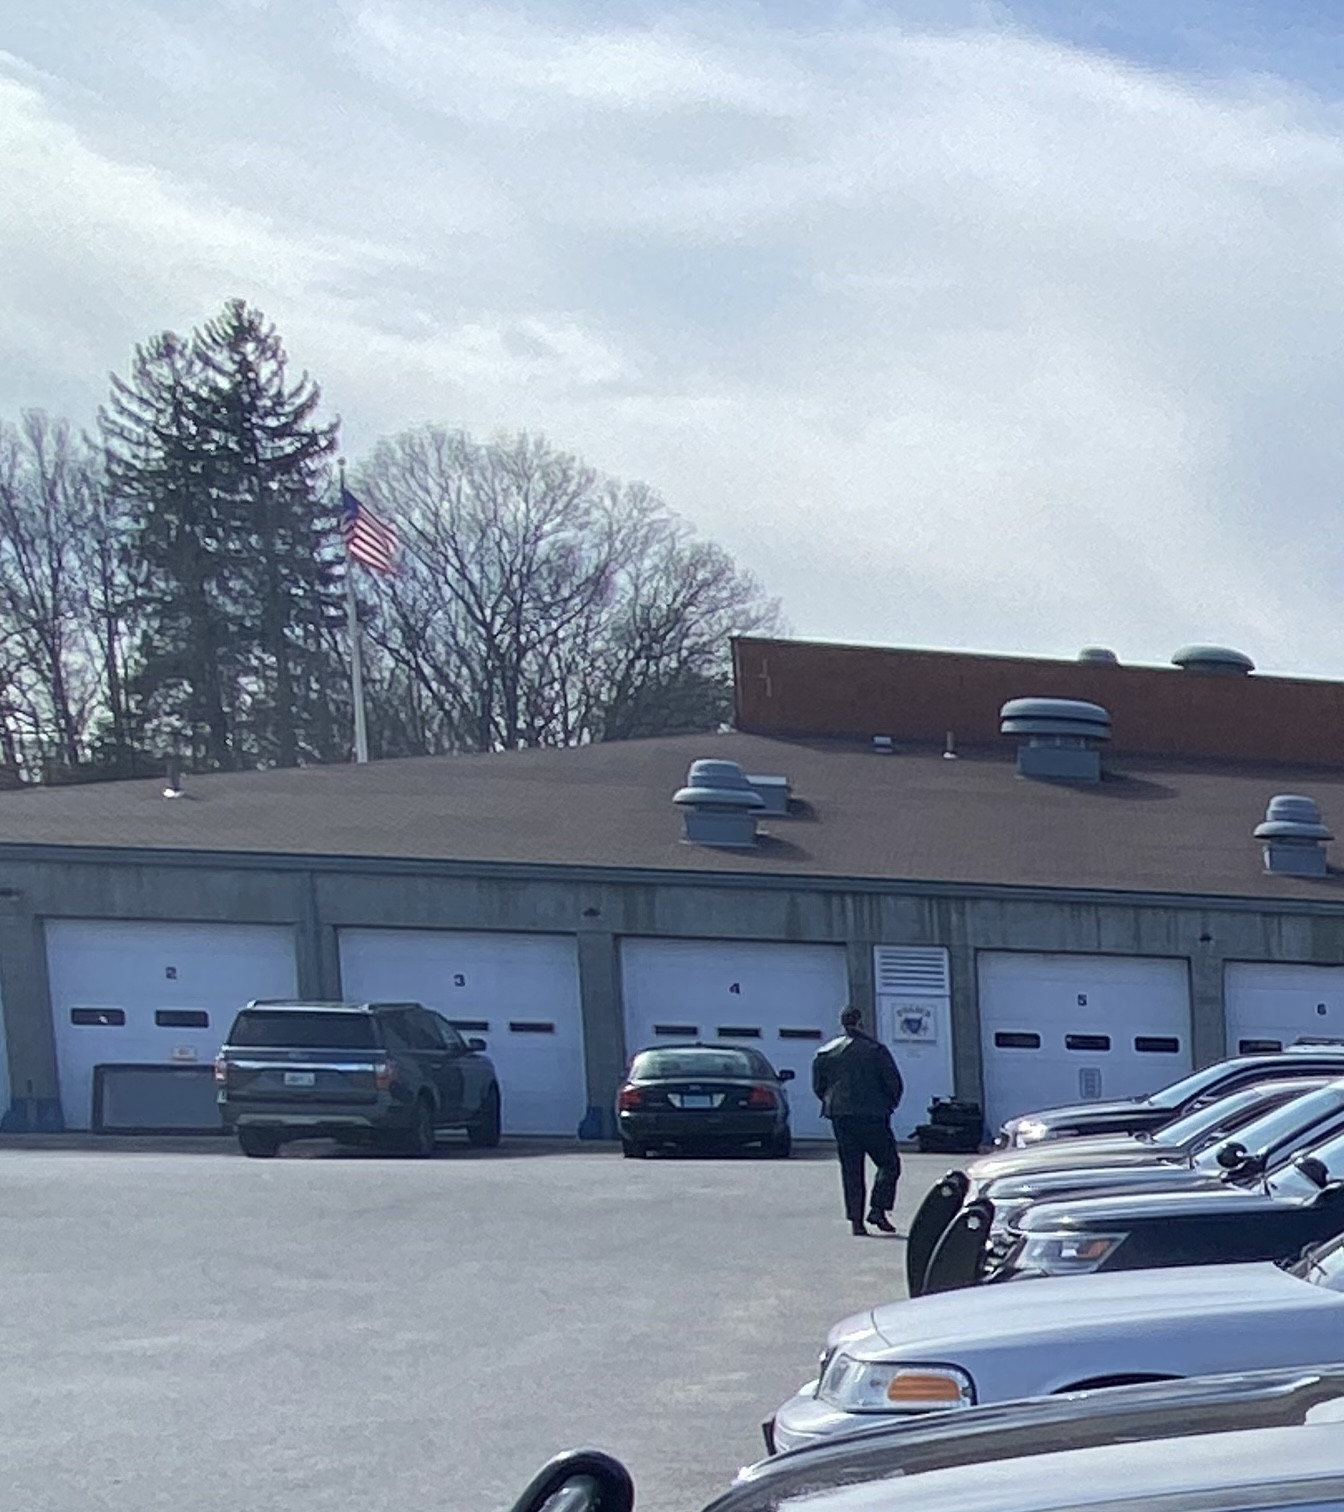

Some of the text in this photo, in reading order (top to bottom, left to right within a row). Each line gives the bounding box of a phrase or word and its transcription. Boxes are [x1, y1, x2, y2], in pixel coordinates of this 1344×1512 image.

[165, 966, 177, 979] 2
[453, 974, 466, 987] 3
[729, 982, 740, 994] 4
